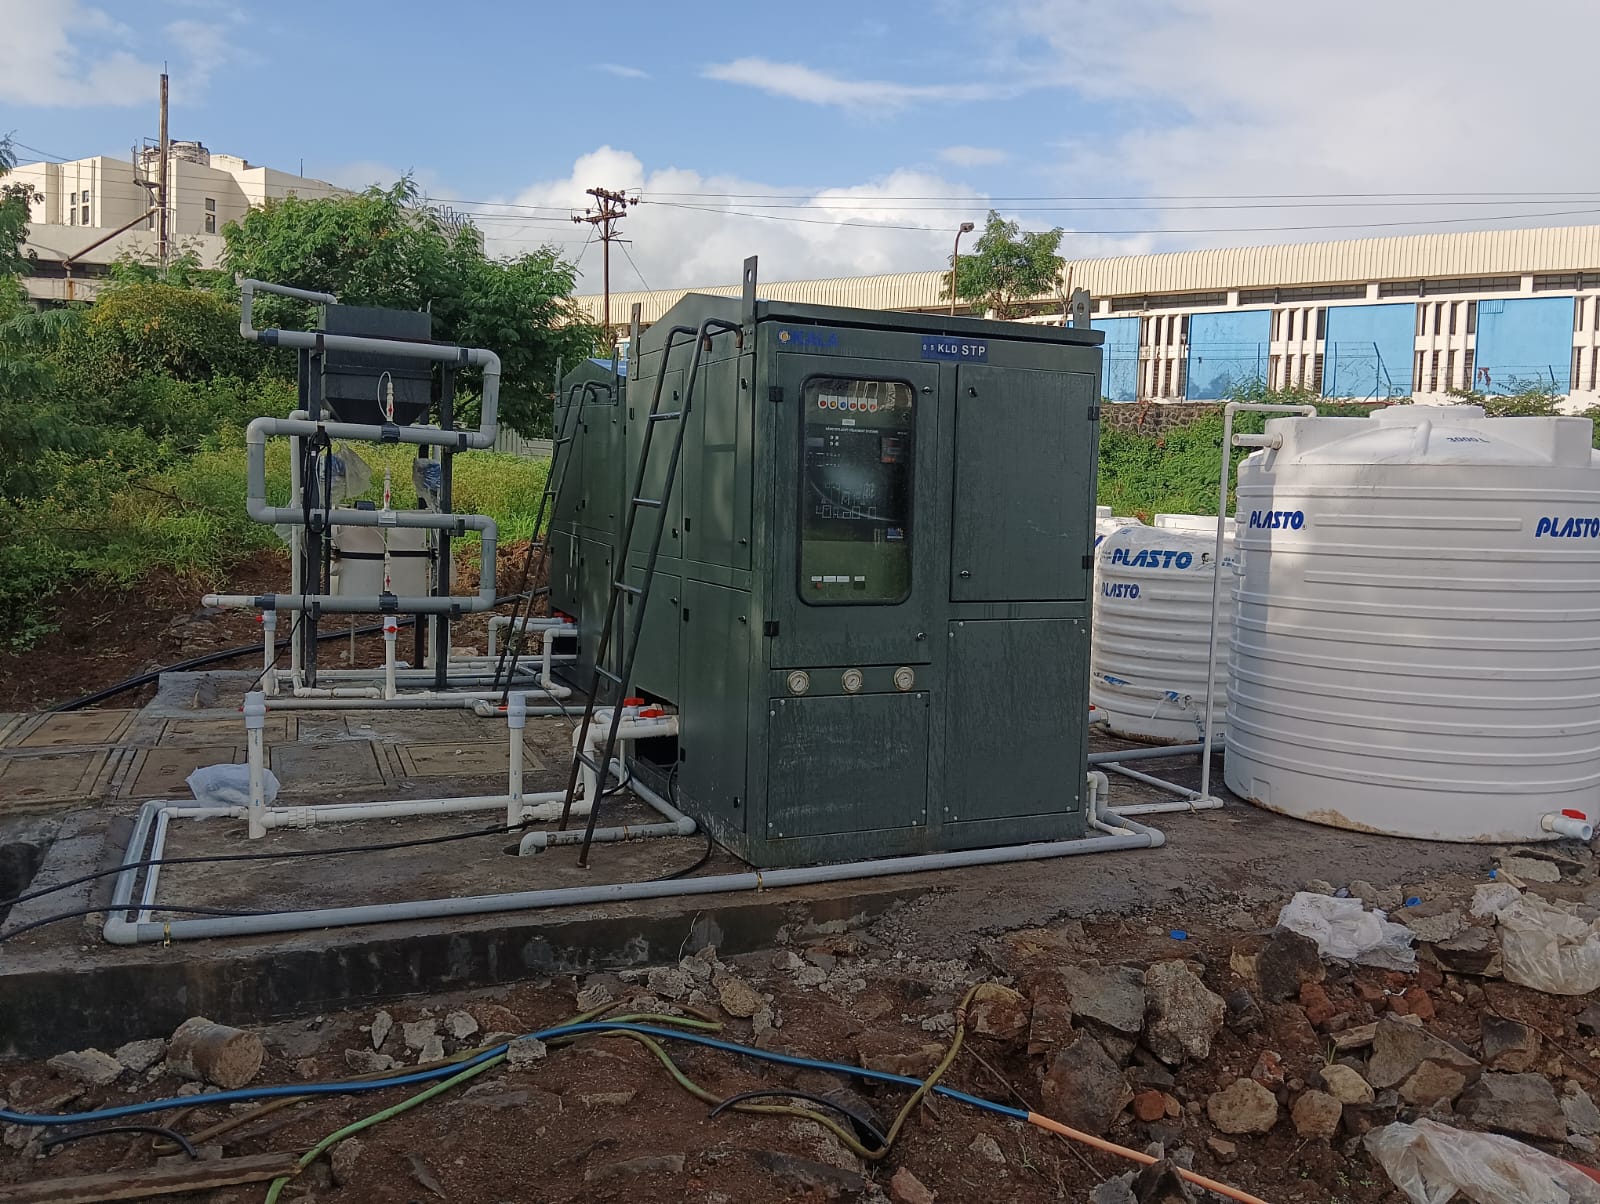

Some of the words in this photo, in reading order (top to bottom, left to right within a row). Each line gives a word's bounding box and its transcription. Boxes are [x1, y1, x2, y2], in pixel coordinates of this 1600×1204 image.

[937, 343, 958, 354] KLD
[961, 344, 986, 356] STP
[1249, 510, 1304, 530] PLASTO
[1535, 517, 1600, 538] PLASTO
[1111, 548, 1193, 569] PLASTO
[1101, 582, 1140, 599] PLASTO
